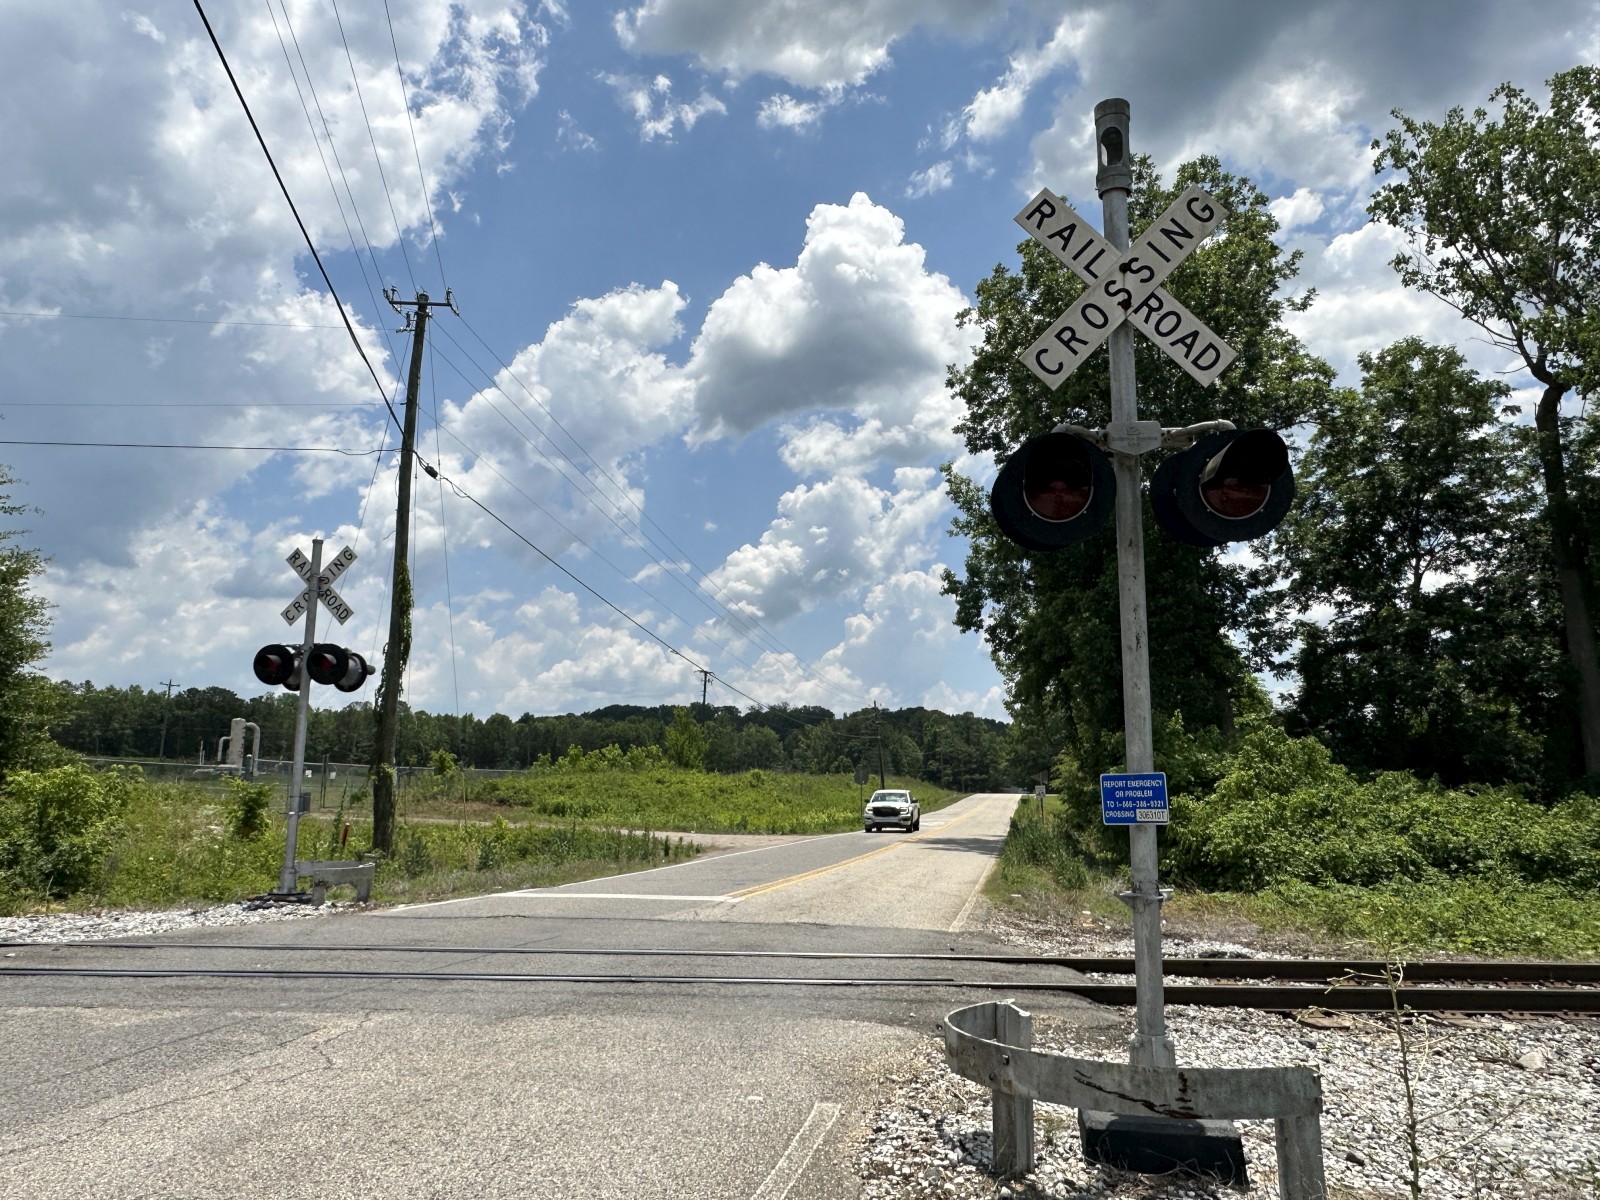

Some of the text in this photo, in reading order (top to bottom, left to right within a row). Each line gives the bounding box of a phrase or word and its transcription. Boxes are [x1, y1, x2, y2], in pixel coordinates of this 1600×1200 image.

[1026, 198, 1221, 371] RAIL ROAD
[1035, 197, 1215, 375] CROSSING
[321, 588, 349, 620] ROAD
[1103, 779, 1162, 788] REPORT EMERGENCY
[1125, 789, 1153, 797] PROBLEM
